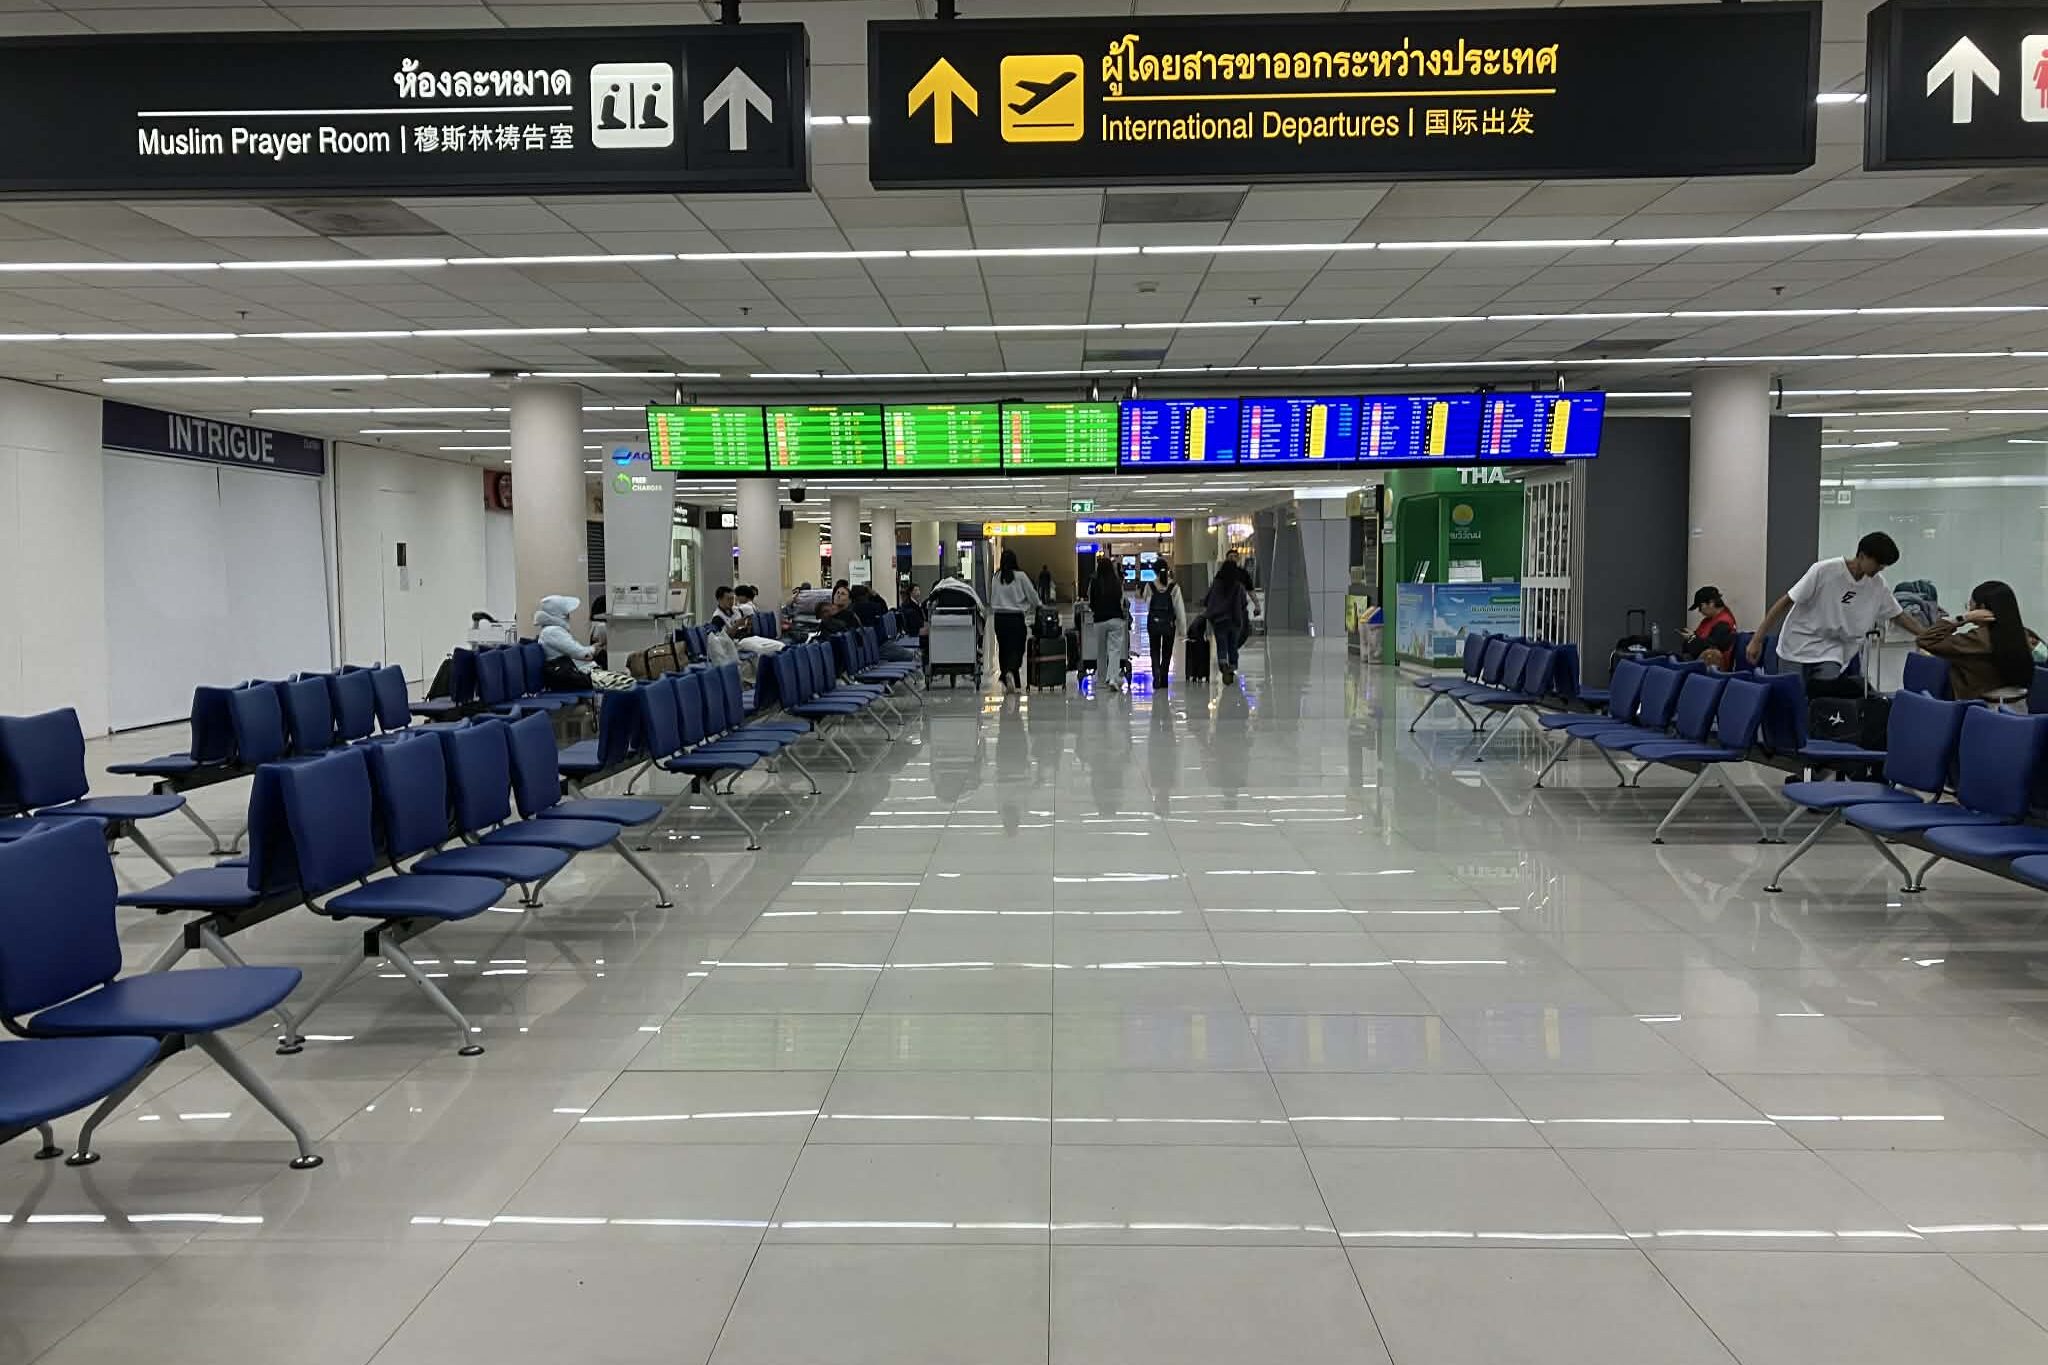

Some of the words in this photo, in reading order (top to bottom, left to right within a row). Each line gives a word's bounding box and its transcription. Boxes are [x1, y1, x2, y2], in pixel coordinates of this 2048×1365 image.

[394, 57, 572, 99] ห้องละหมาด
[1102, 34, 1559, 97] ผู้โดยสารขาออกระหว่างประเทศ
[413, 123, 574, 152] 穆斯林祷告室
[1102, 111, 1252, 141] International
[1263, 111, 1400, 145] Departures
[1425, 107, 1534, 135] 国际出发
[138, 127, 223, 156] Muslim
[231, 127, 312, 161] Prayer
[318, 126, 390, 153] Room
[168, 414, 275, 463] INTRIGUE
[632, 451, 651, 461] AO
[1456, 466, 1523, 484] THA
